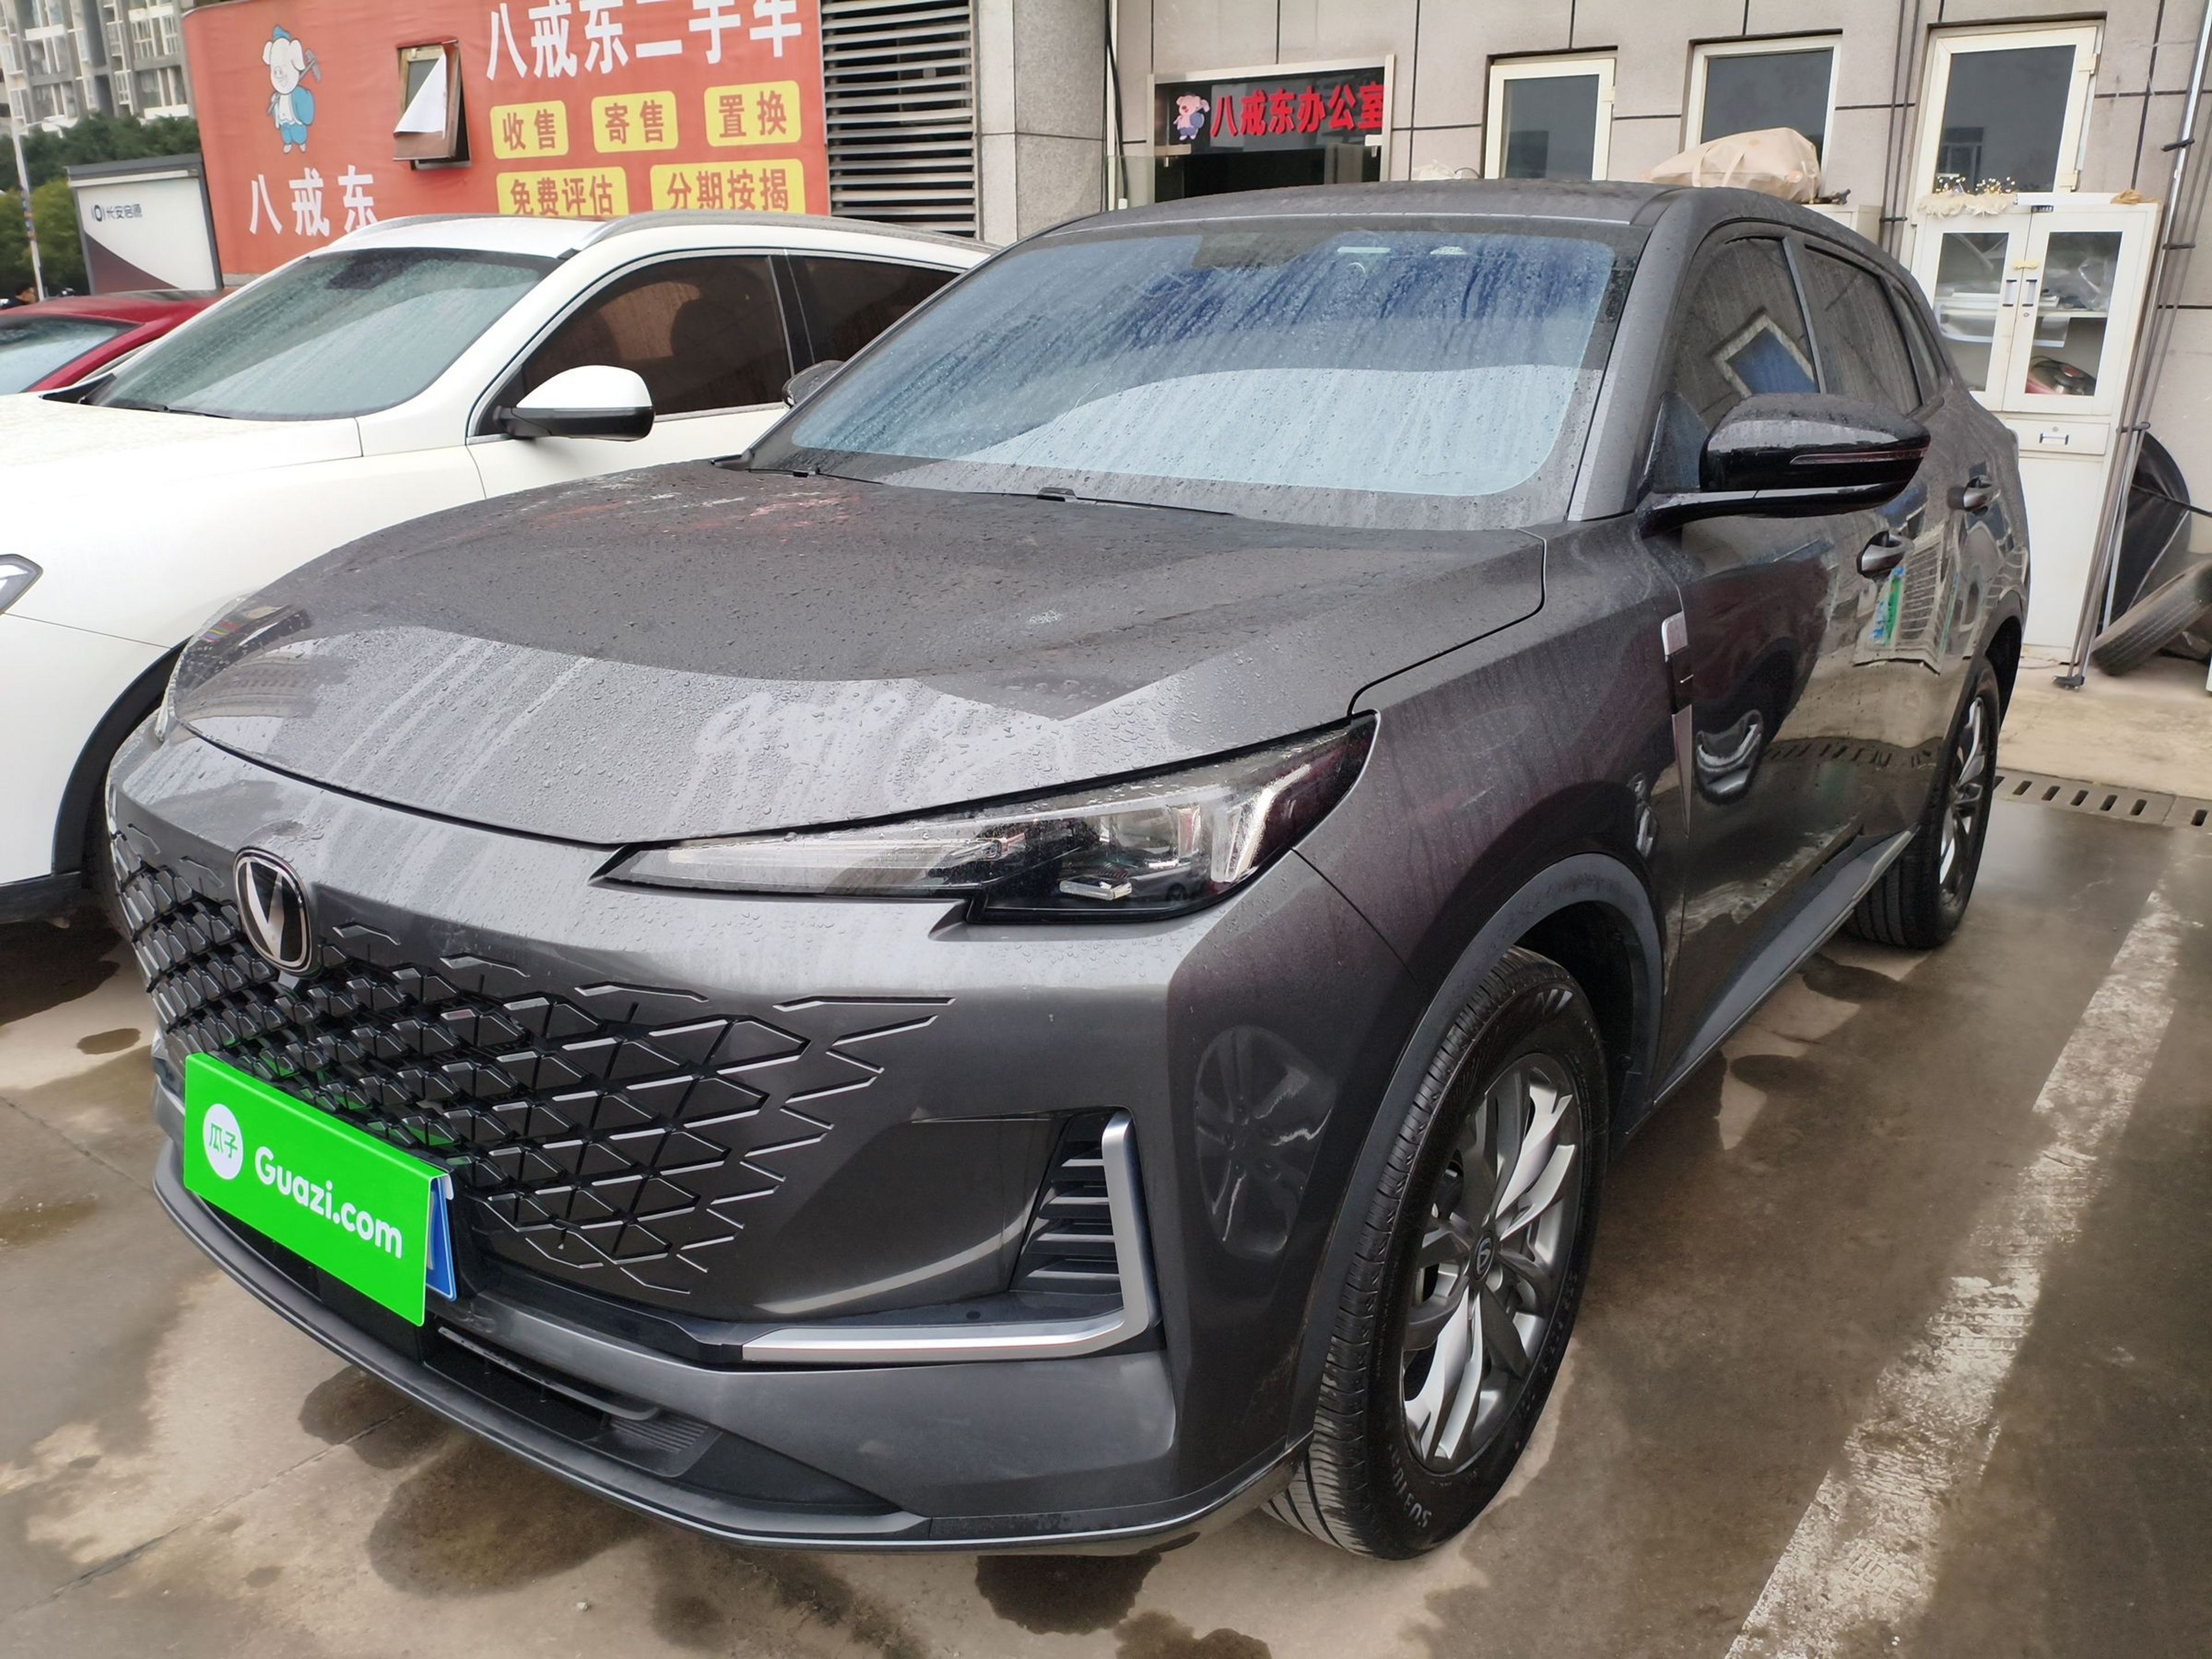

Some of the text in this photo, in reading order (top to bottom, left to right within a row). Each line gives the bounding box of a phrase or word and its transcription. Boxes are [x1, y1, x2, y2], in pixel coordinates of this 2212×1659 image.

[486, 0, 802, 81] 八戒东二手车
[502, 90, 787, 151] 收售 寄售 置换
[1211, 81, 1385, 137] 八戒东办公室
[249, 164, 378, 237] 八戒东
[510, 168, 789, 216] 免费评估 分期按揭
[209, 1122, 238, 1158] 瓜子
[255, 1146, 403, 1259] Guazi.com
